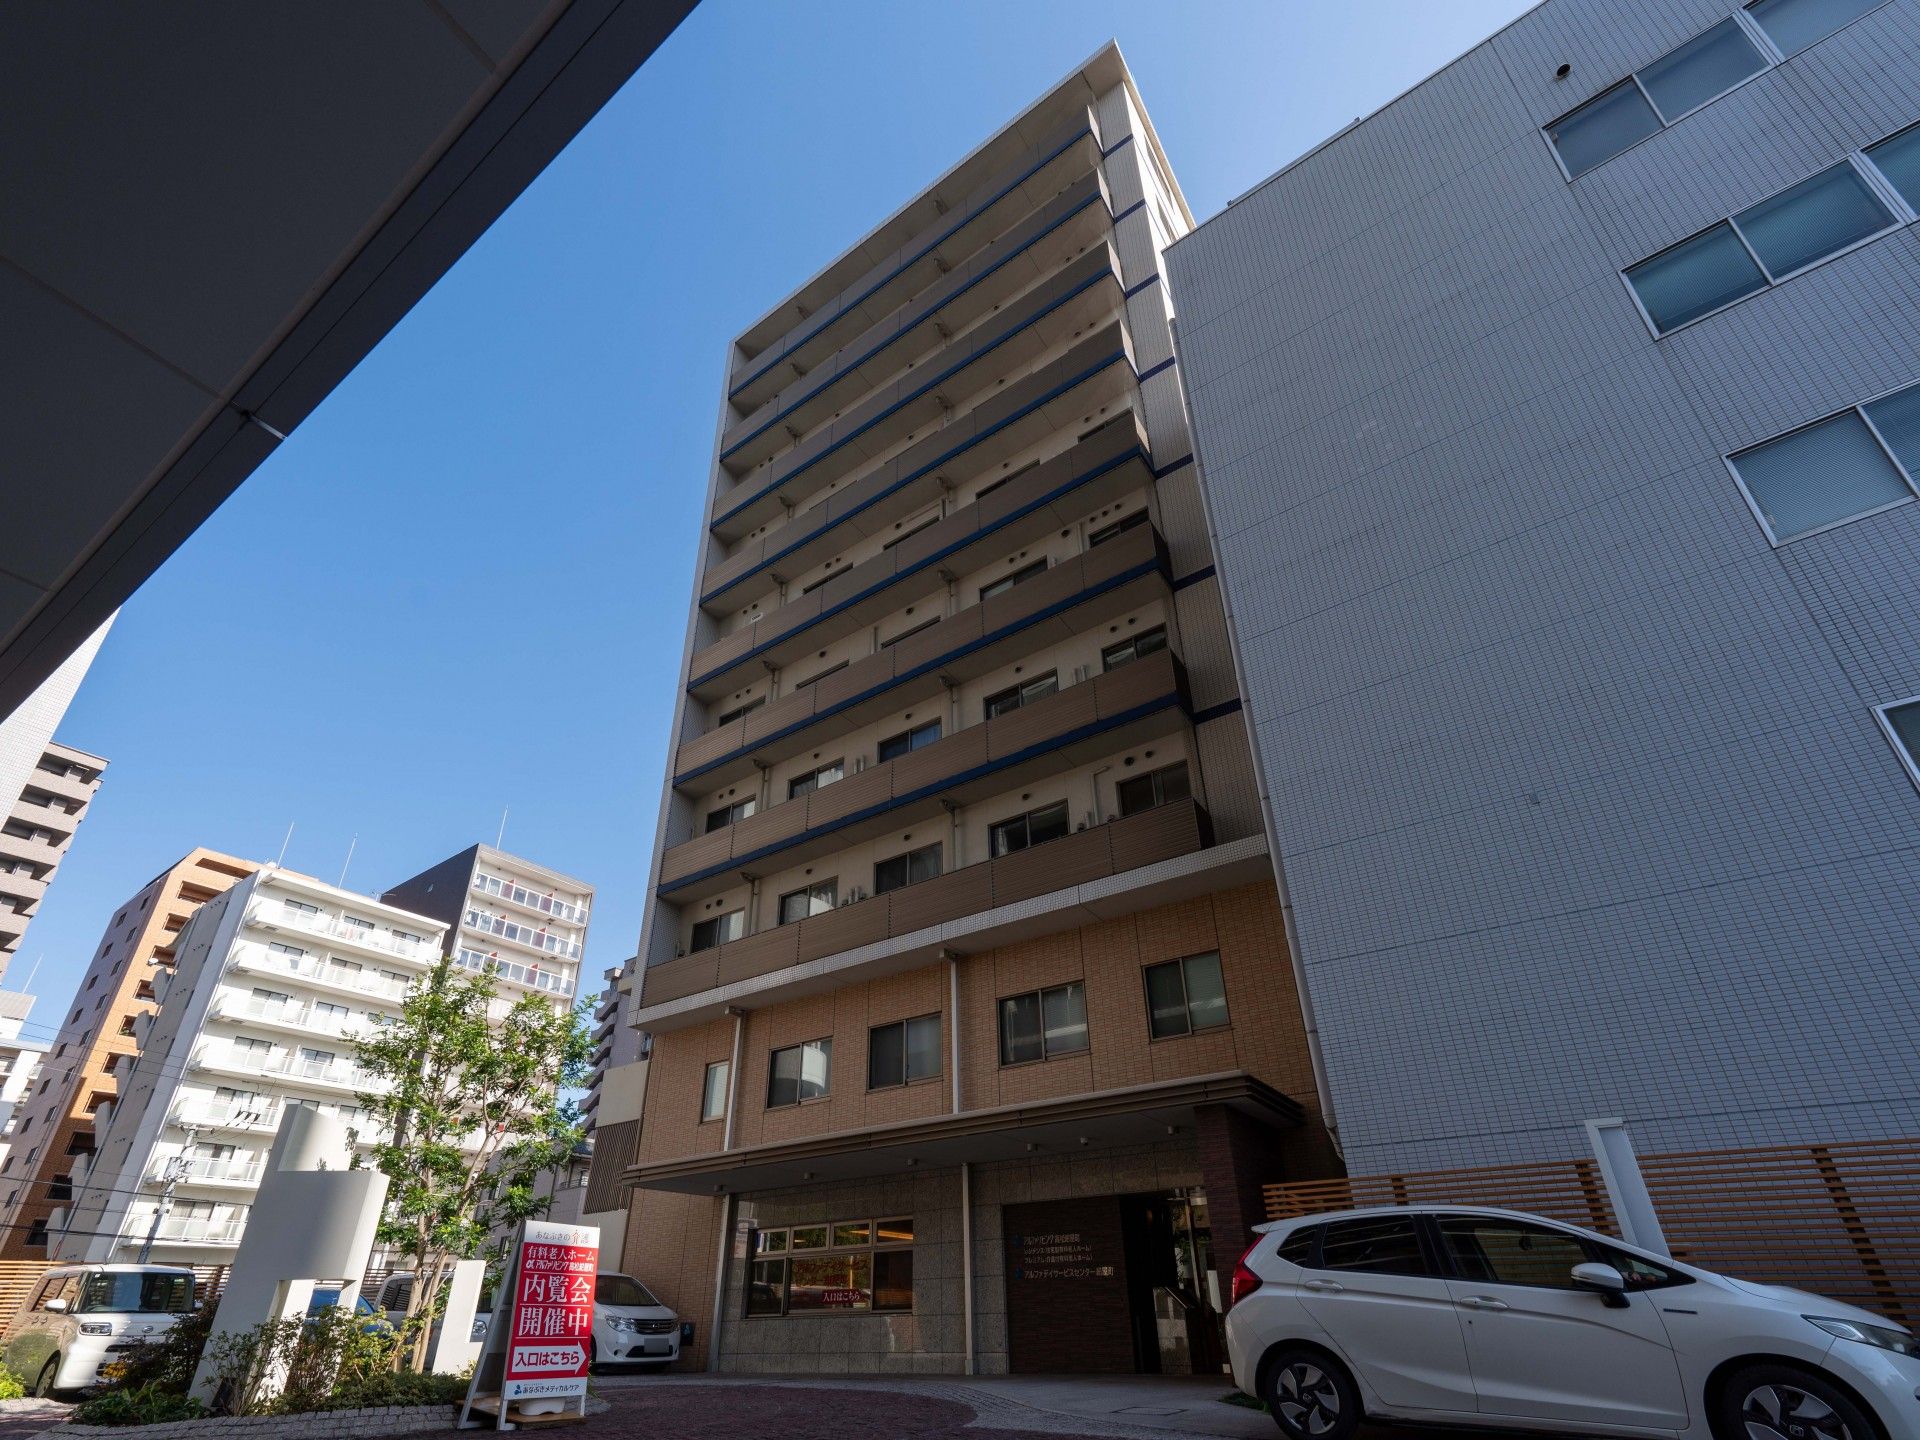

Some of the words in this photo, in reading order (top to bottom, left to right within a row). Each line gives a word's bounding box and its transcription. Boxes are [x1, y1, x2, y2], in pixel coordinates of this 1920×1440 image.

[528, 1246, 595, 1260] 有料老人ホーム
[523, 1275, 592, 1304] 内覧会
[823, 1291, 860, 1302] 入口はこちら
[518, 1307, 588, 1337] 開催中
[515, 1351, 580, 1367] 入口はこちら
[522, 1384, 580, 1395] あなぶきメディカルケア
